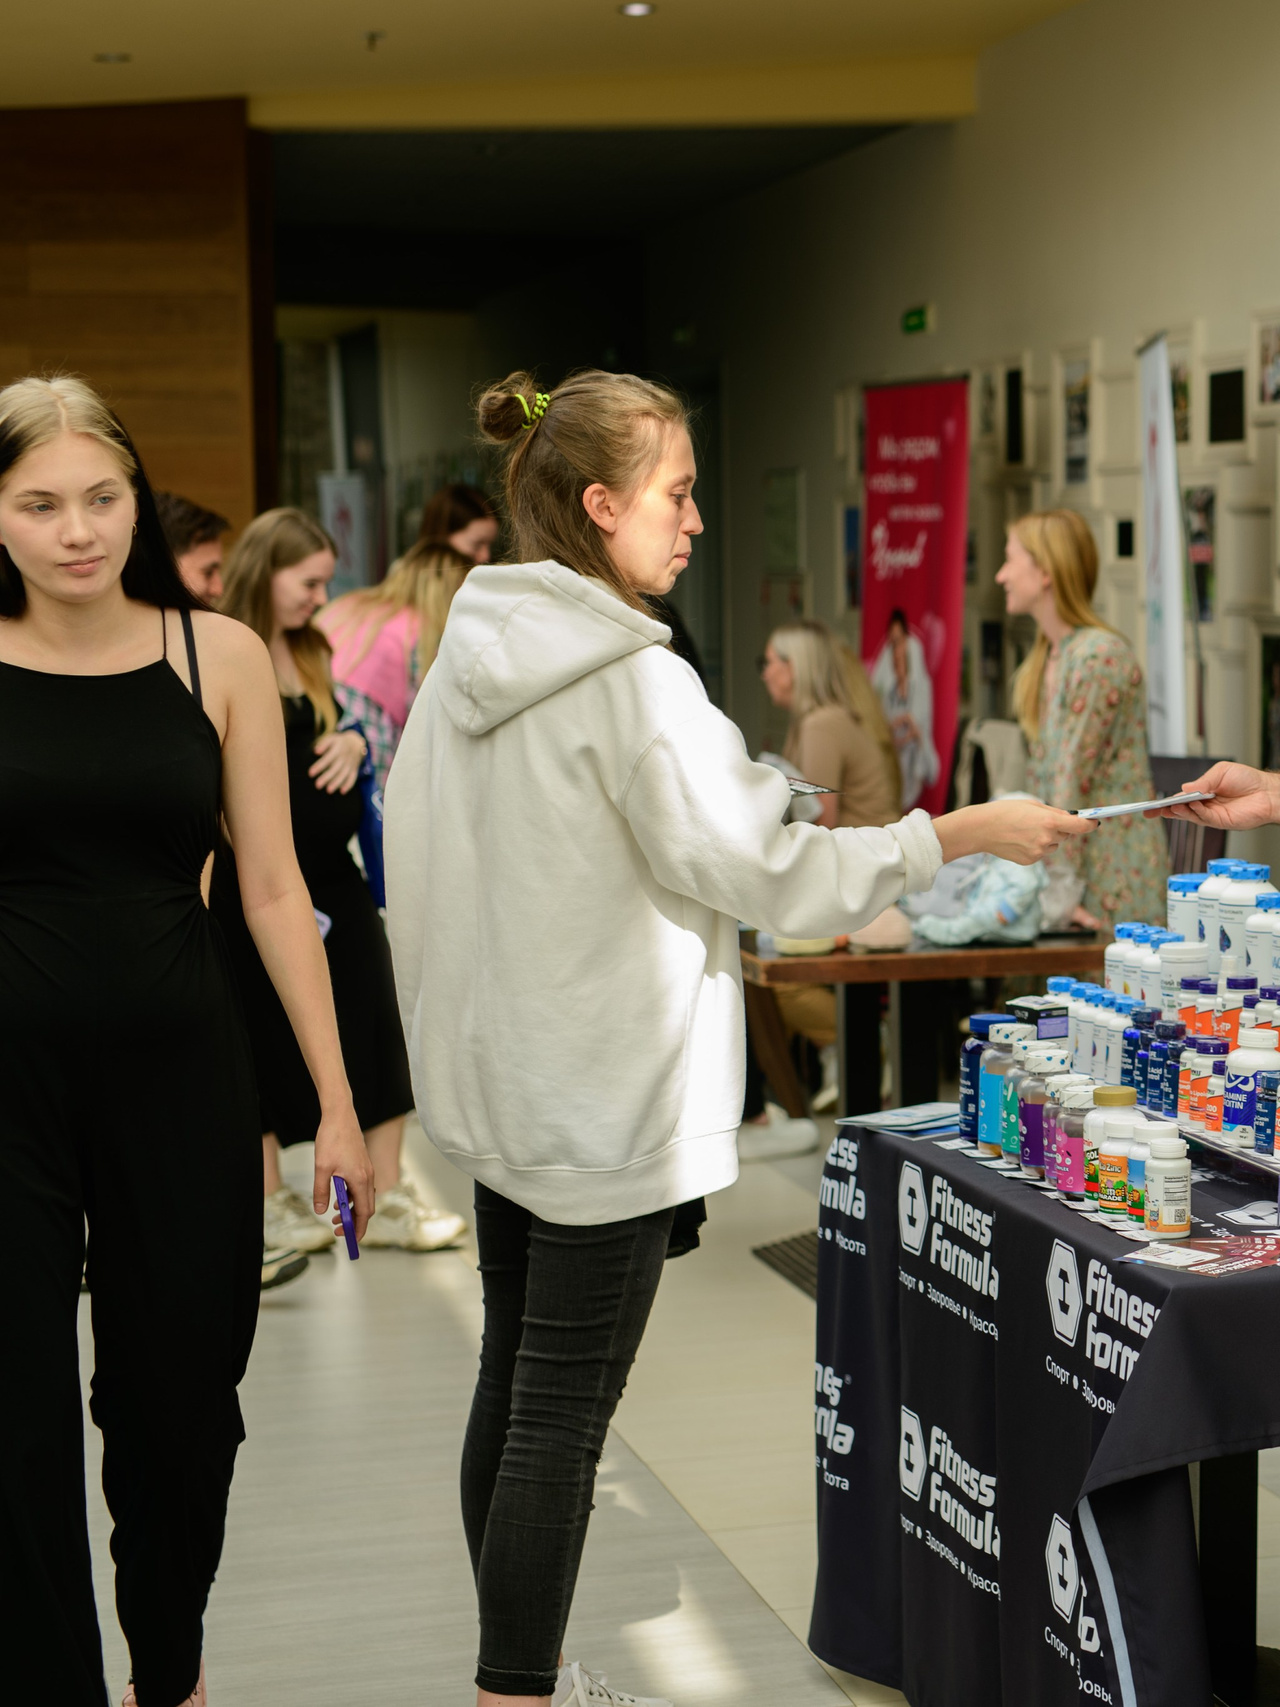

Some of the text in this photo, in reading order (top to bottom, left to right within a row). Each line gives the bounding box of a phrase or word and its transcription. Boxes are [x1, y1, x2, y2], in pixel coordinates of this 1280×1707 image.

[1224, 1091, 1248, 1103] AMINE
[1086, 1151, 1099, 1161] GOL
[930, 1174, 993, 1248] Fitness
[929, 1221, 1000, 1301] Formula
[926, 1282, 962, 1317] Здоровье
[1085, 1258, 1162, 1339] Fitnes
[1085, 1311, 1141, 1382] Form
[1045, 1355, 1071, 1385] Спорт
[928, 1425, 997, 1508] Fitness
[967, 1564, 1001, 1602] Красо
[1044, 1626, 1069, 1660] Спорт
